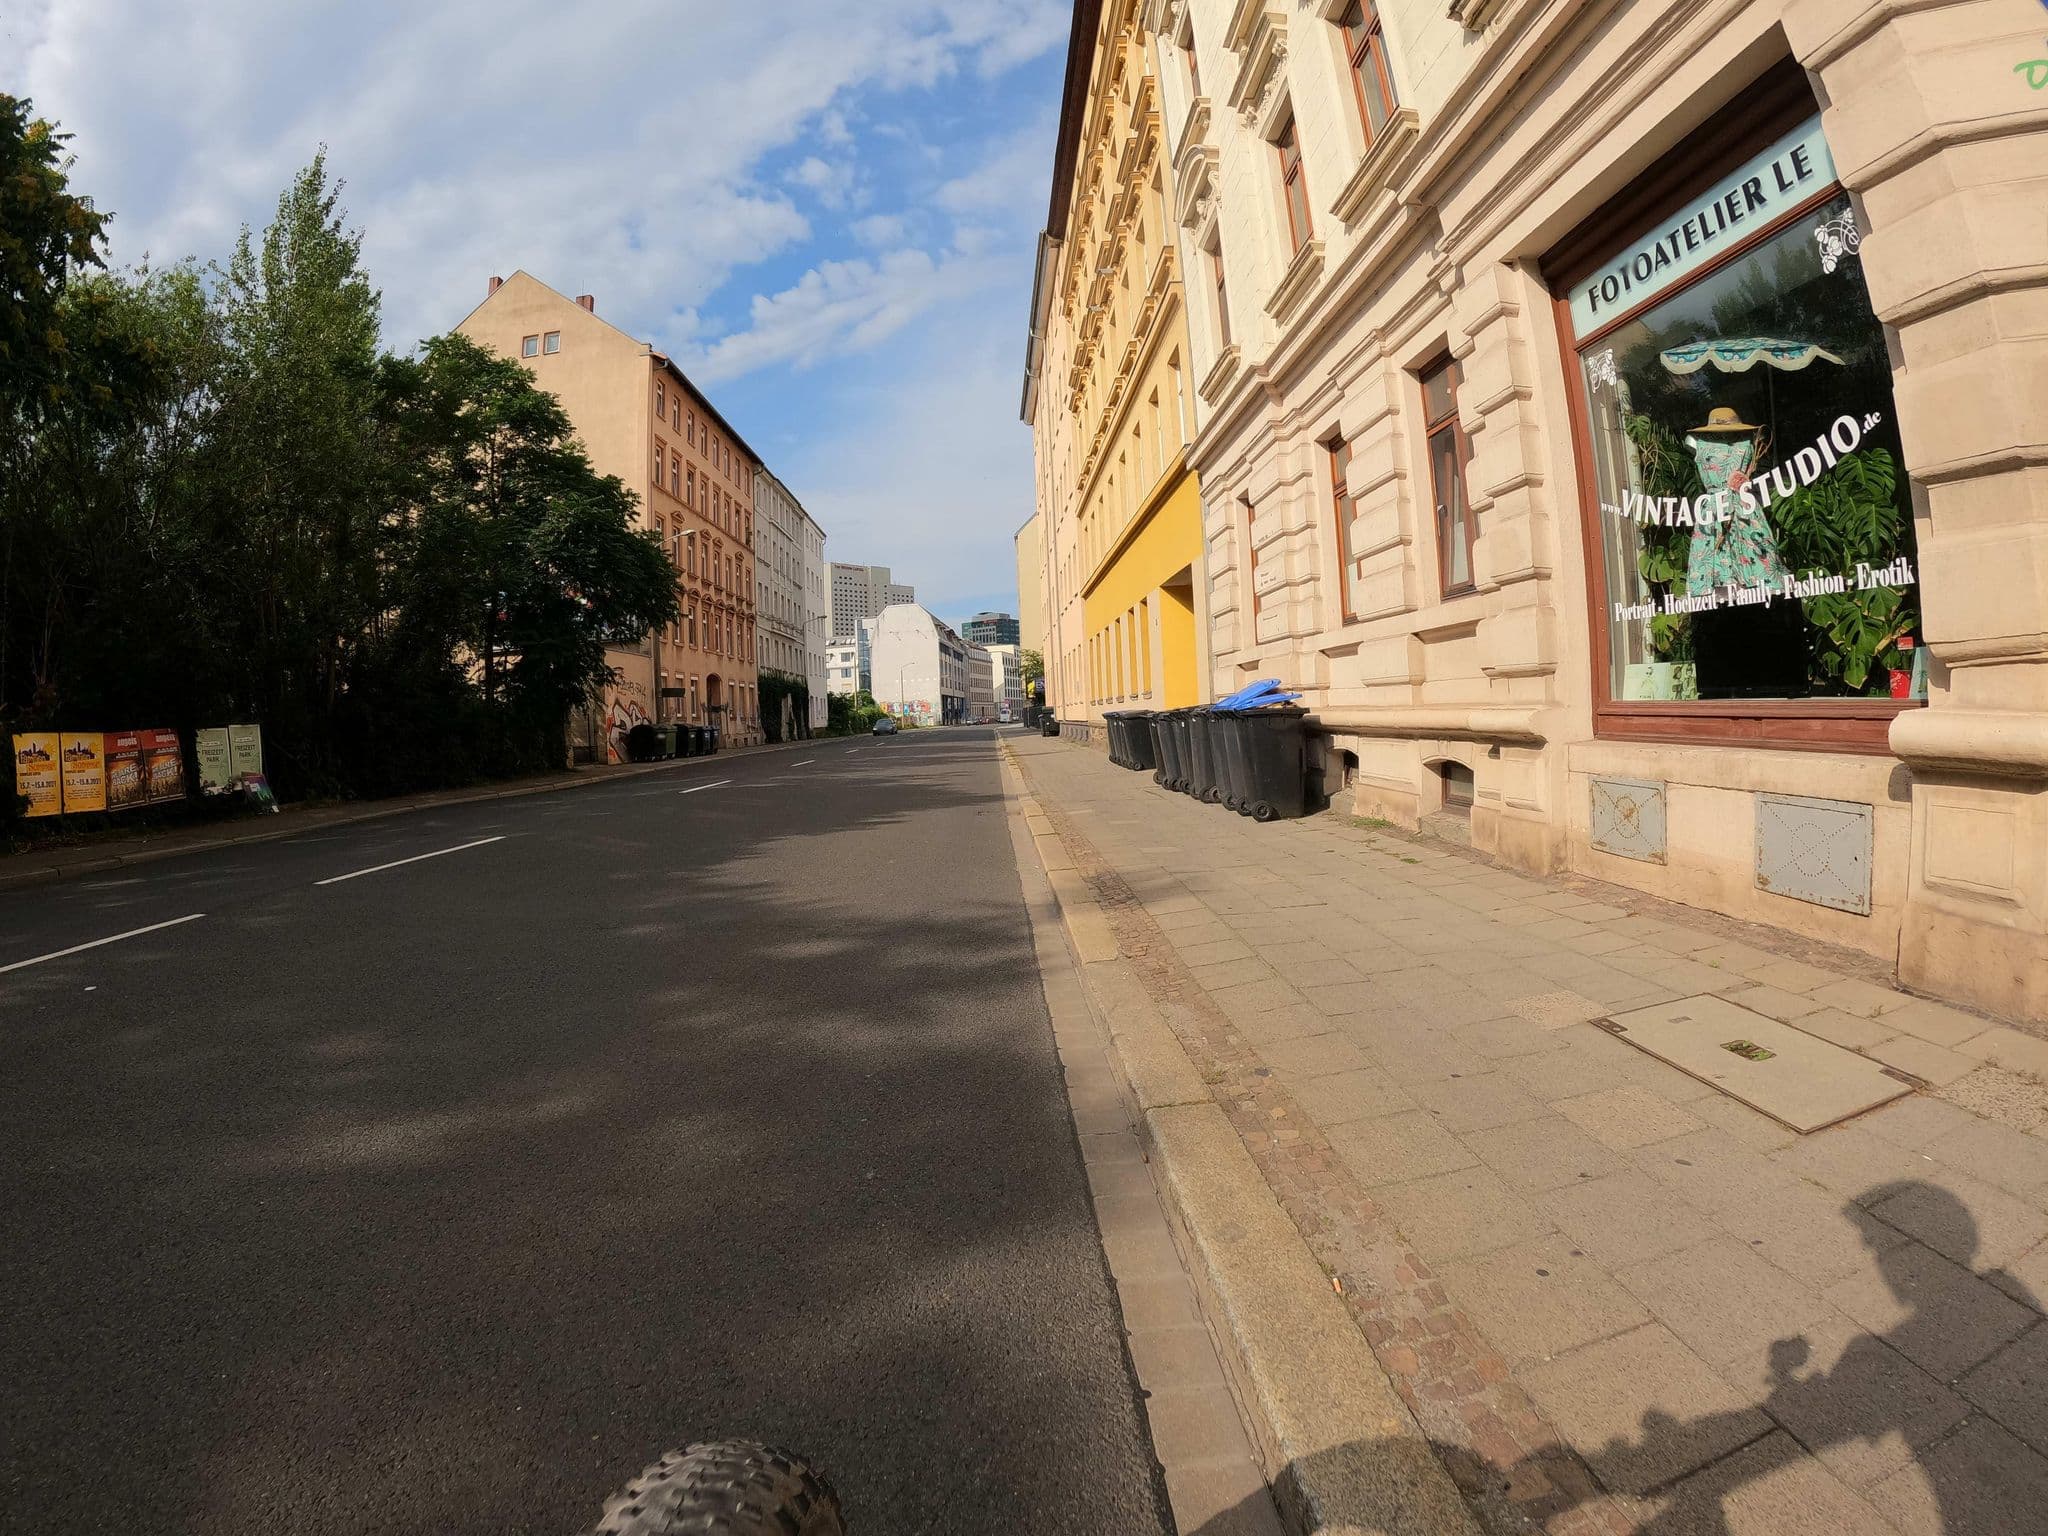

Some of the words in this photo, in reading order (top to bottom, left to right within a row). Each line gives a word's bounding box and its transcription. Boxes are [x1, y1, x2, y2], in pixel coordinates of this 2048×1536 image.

[1588, 176, 1767, 313] FOTOATELIER
[1772, 143, 1813, 193] LE
[1615, 598, 1656, 622] Portrait
[1664, 590, 1718, 616] Hochzeit
[1726, 578, 1773, 609] Family
[1783, 571, 1845, 600] Fashion
[1855, 556, 1916, 591] Erotik
